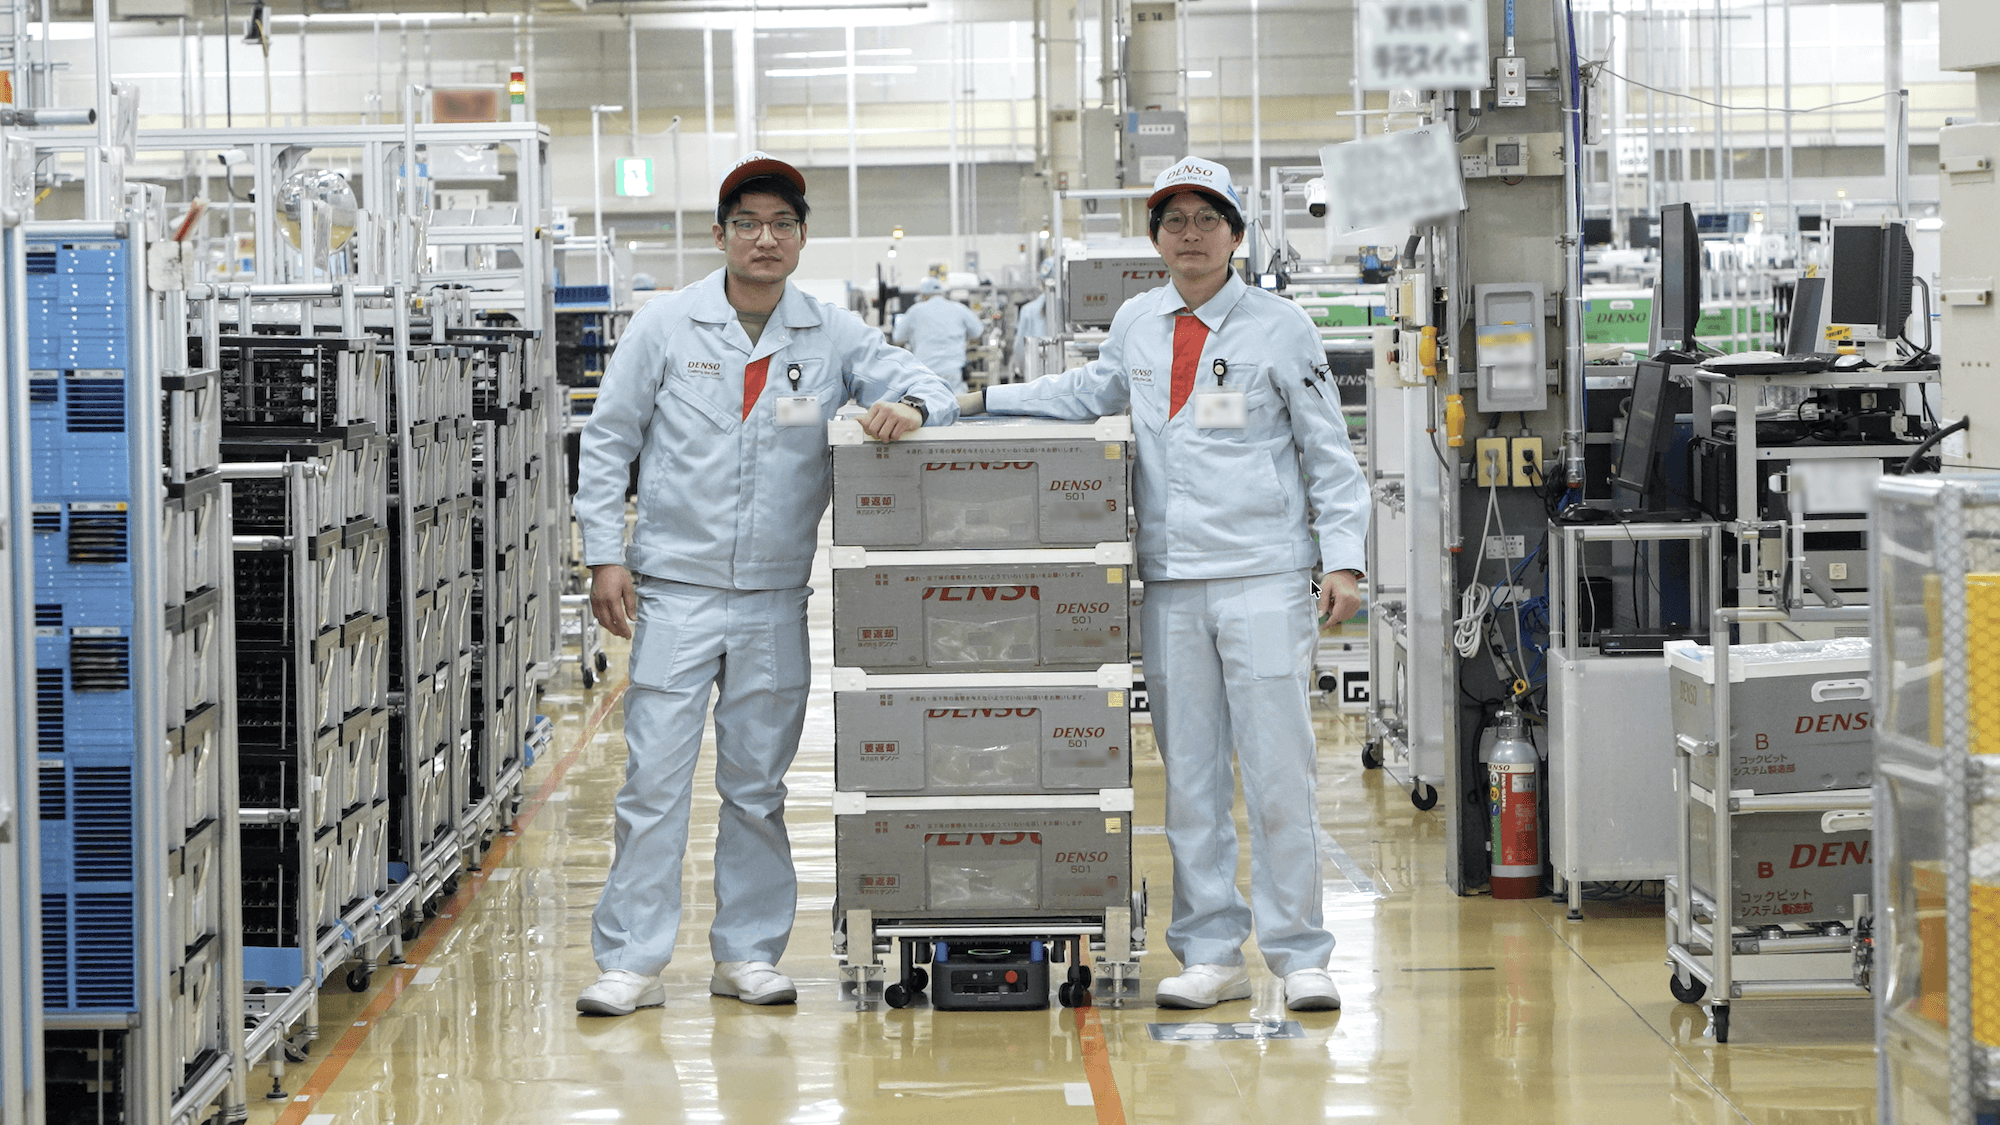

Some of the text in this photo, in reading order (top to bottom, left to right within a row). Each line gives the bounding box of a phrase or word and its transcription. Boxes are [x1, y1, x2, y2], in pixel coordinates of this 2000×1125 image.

[1166, 165, 1213, 180] DENSO
[1597, 312, 1647, 324] DENSO
[688, 361, 720, 370] DENSO
[1050, 480, 1102, 491] DENSO
[860, 496, 892, 506] 要返却
[1065, 492, 1086, 500] 501
[1056, 602, 1110, 614] DENSO
[1072, 616, 1092, 624] 501
[862, 628, 894, 640] 要返却
[1794, 712, 1874, 734] DENS
[1052, 727, 1105, 738] DENSO
[1068, 740, 1088, 748] 501
[1756, 734, 1769, 750] B
[864, 743, 896, 753] 要返却
[1740, 754, 1788, 765] コックピット
[1733, 764, 1796, 776] システム製造部
[1054, 852, 1108, 863] DENSO
[1789, 841, 1873, 869] DEN
[1070, 865, 1091, 874] 501
[1757, 862, 1774, 879] B
[1741, 888, 1812, 902] コックピット
